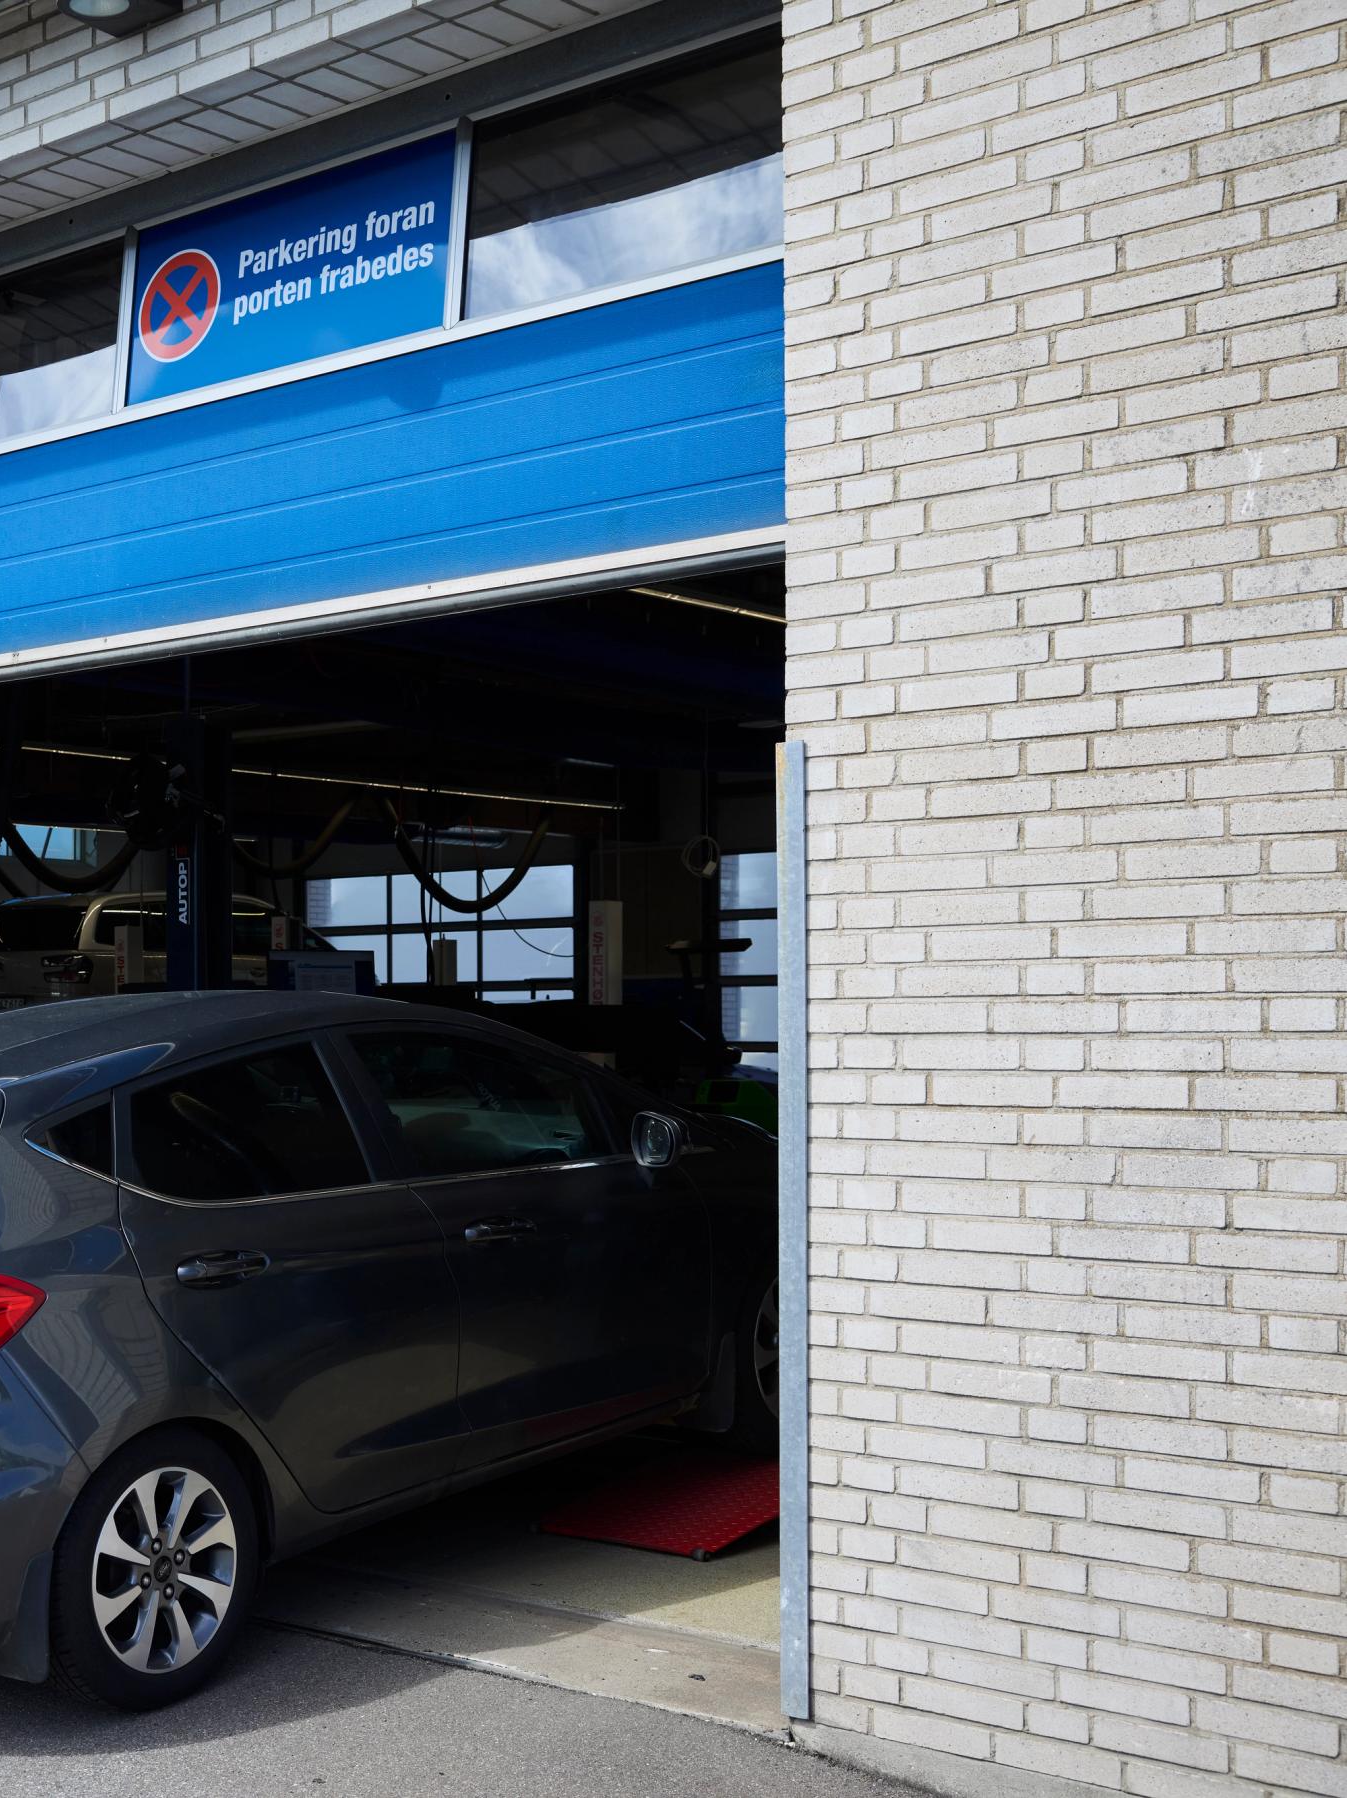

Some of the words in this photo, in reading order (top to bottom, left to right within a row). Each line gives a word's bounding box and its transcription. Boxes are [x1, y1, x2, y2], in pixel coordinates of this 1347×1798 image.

[238, 223, 357, 279] Parkering
[365, 200, 434, 242] foran
[233, 276, 311, 325] porten
[319, 242, 434, 295] frabedes
[177, 861, 188, 925] AUTOP
